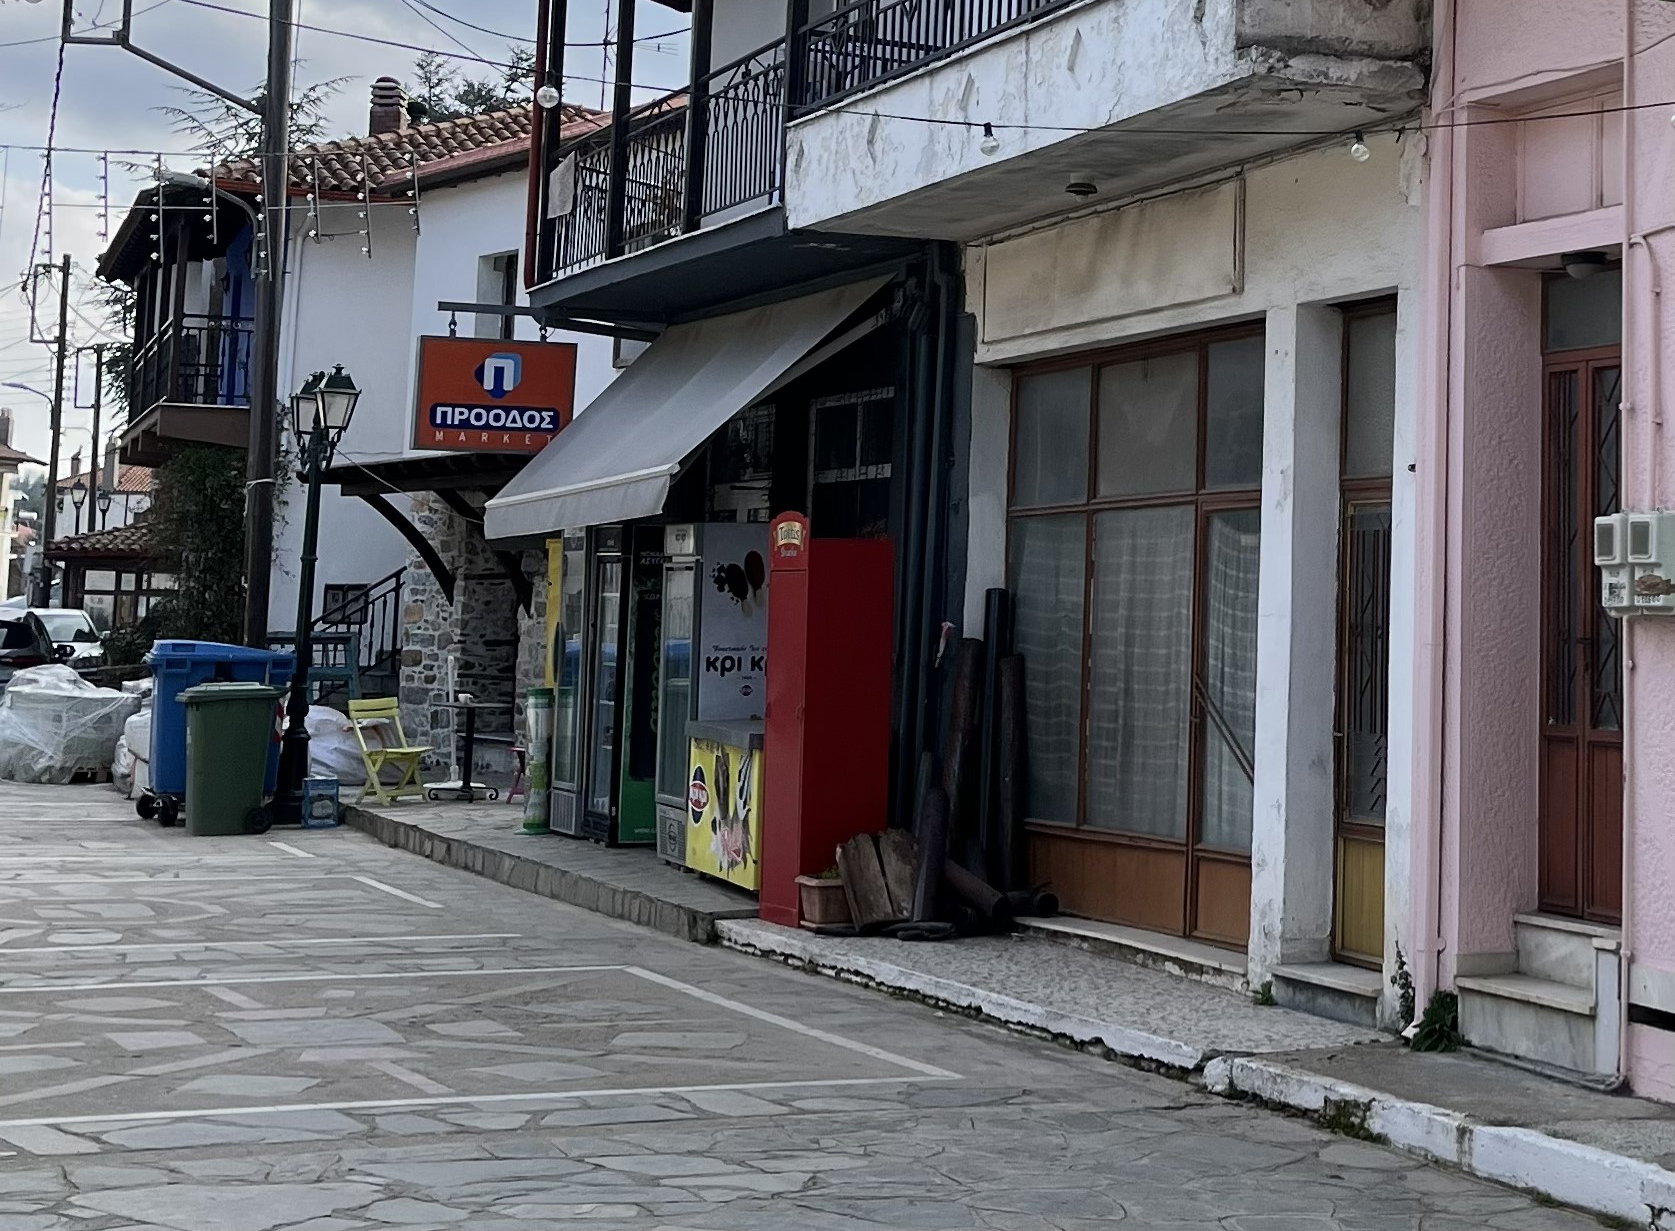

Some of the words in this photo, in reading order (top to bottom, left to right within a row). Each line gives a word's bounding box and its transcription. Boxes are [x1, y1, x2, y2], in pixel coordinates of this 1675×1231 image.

[435, 406, 554, 429] ΠΡΟΟΔΟΣ
[435, 431, 552, 445] MARKET
[750, 655, 768, 677] κ
